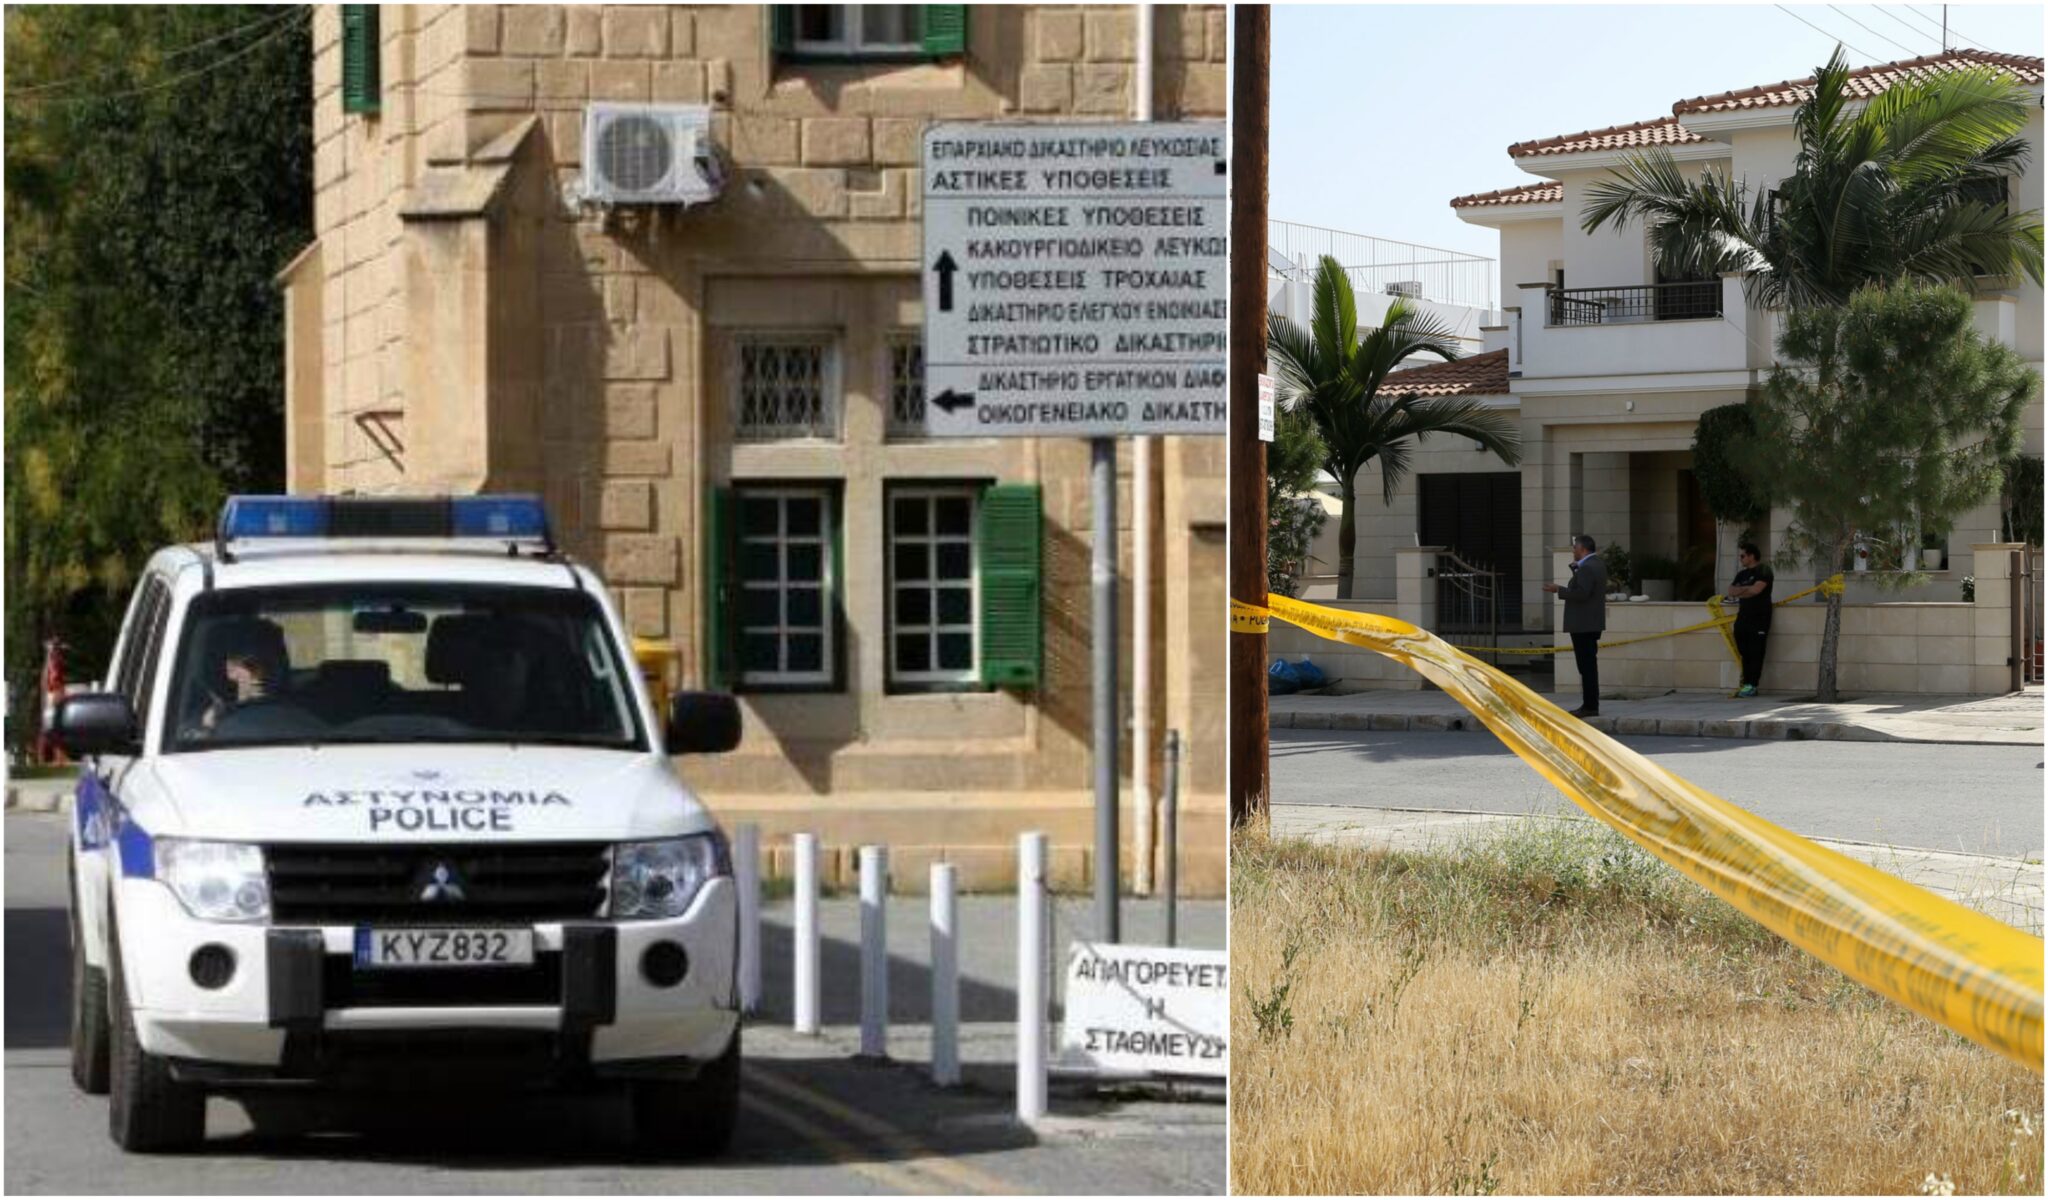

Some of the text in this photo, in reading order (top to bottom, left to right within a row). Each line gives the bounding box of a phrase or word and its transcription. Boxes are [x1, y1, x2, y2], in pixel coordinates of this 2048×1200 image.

[932, 137, 1219, 159] ΕΠΑΡΧΙΑΚΟ ΔΙΚΑΣΤΗΡΙΟ ΛΕΥΚΩΣΙΑΣ
[932, 168, 1173, 190] ΑΣΤΙΚΕΣ ΥΠΟΘΕΣΕΙΣ
[968, 206, 1204, 226] ΠΟΙΝΙΚΕΣ ΥΠΟΘΕΣΕΙΣ
[967, 236, 1226, 259] ΚΑΚΟΥΡΓΙΟΔΙΚΕΙΟ ΛΕΥΚΩ
[967, 270, 1207, 289] ΥΠΟΘΕΣΕΙΣ ΤΡΟΧΑΙΑΣ
[968, 302, 1063, 322] ΔΙΚΑΣΤΗΡΙΟ
[1068, 301, 1141, 321] ΕΛΕΓΧΟΥ
[967, 332, 1226, 355] ΣΤΡΑΤΙΩΤΙΚΟ ΔΙΚΑΣΤΗΡΙ
[979, 370, 1078, 391] ΔΙΚΑΣΤΗΡΙΟ
[1084, 370, 1177, 391] ΕΡΓΑΤΙΚΩΝ
[978, 401, 1226, 424] ΟΙΚΟΓΕΝΕΙΑΚΟ ΔΙΚΑΣΤΗ
[304, 790, 573, 806] ΑΣΤΥΝΟΜΙΑ
[369, 807, 513, 832] POLICE
[381, 931, 508, 962] KYZ832
[1076, 957, 1226, 988] ΑΠΑΓΟΡΕΥΕΤ
